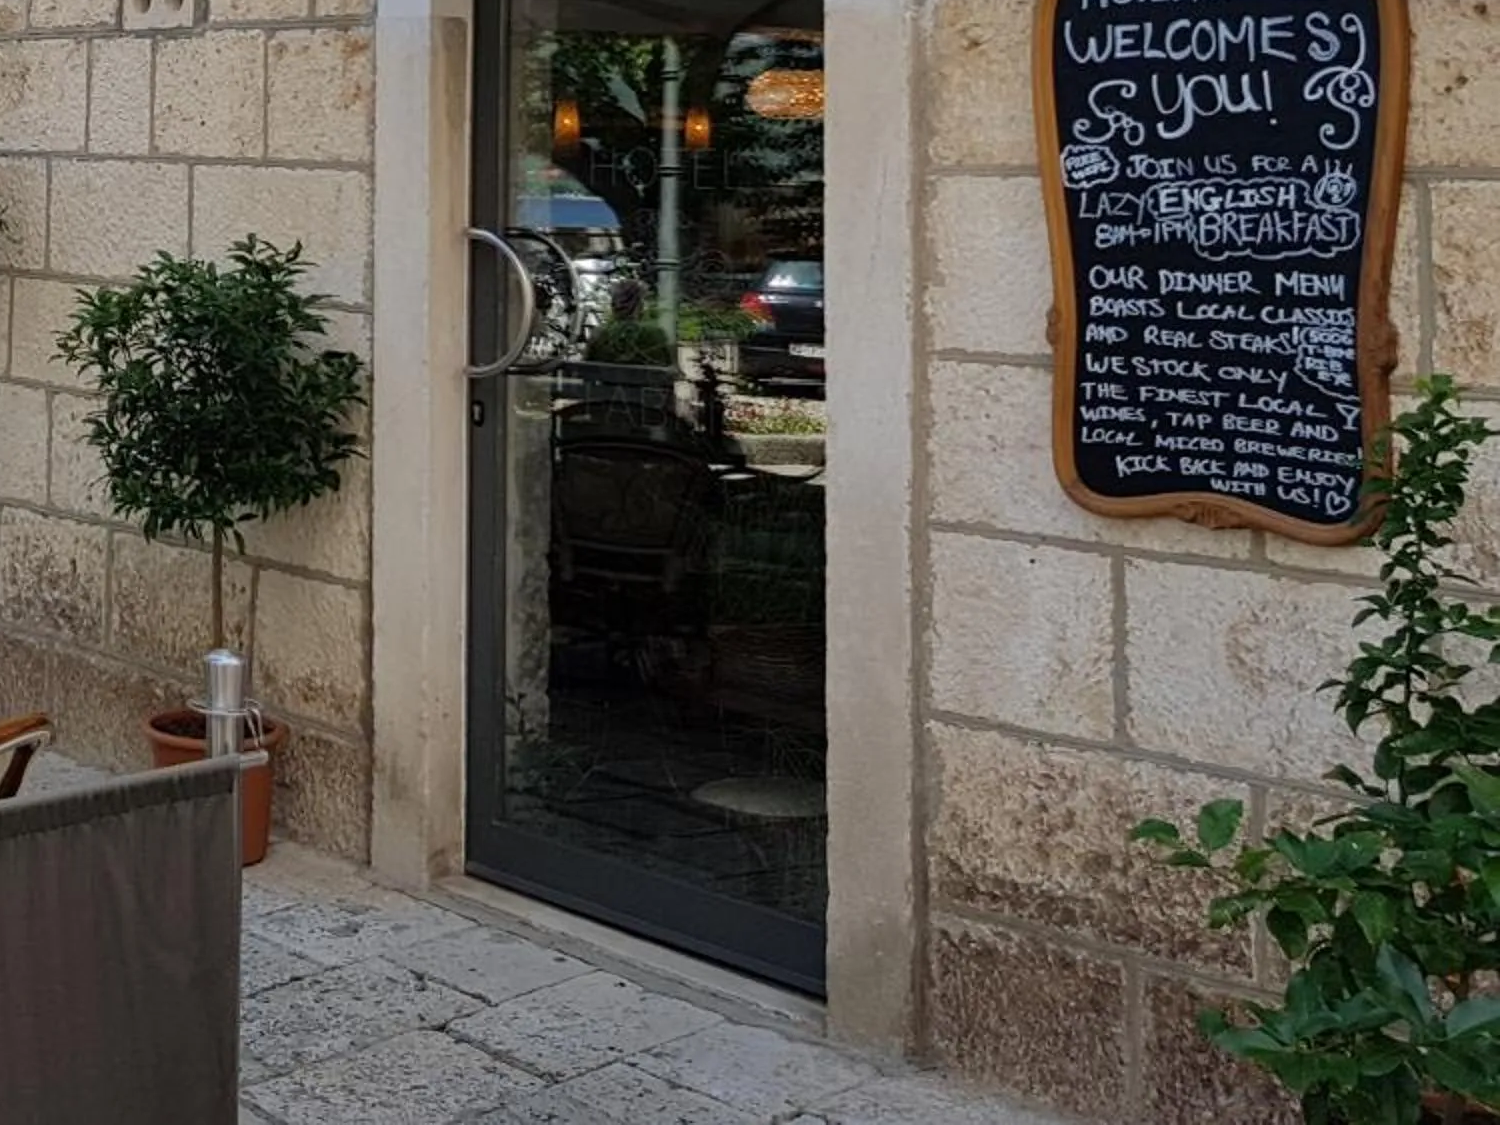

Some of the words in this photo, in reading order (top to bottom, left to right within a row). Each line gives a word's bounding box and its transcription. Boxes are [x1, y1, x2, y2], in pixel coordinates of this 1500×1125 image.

[1064, 11, 1341, 64] WELCOMES
[589, 146, 737, 191] HOEL
[1126, 155, 1194, 178] JOIN
[1203, 155, 1237, 175] US
[1252, 155, 1292, 172] FOR
[1301, 154, 1318, 173] A
[1079, 192, 1146, 225] LAZY
[1158, 185, 1296, 215] ENGLISH
[1199, 211, 1352, 246] BREAKFAST
[1089, 265, 1148, 290] OUR
[1159, 272, 1260, 296] DINNER
[1275, 271, 1345, 301] MENU
[1090, 297, 1165, 318] BOASTS
[1177, 301, 1254, 320] LOCAL
[1086, 324, 1128, 344] AND
[1144, 326, 1202, 348] REAL
[1085, 356, 1124, 375] WE
[1132, 356, 1211, 382] STOCK
[1218, 365, 1287, 393] ONLY
[1080, 382, 1128, 401] THE
[1140, 386, 1230, 408] FINEST
[1239, 393, 1328, 418] LOCAL
[1081, 427, 1142, 446] LOCAL
[1167, 412, 1211, 428] TAP
[1223, 417, 1282, 436] BEER
[1290, 422, 1339, 442] AND
[1115, 455, 1171, 477] KICK
[1179, 457, 1226, 475] BACK
[1233, 462, 1269, 478] AND
[1278, 466, 1355, 496] ENJOY
[1210, 477, 1265, 496] WITH
